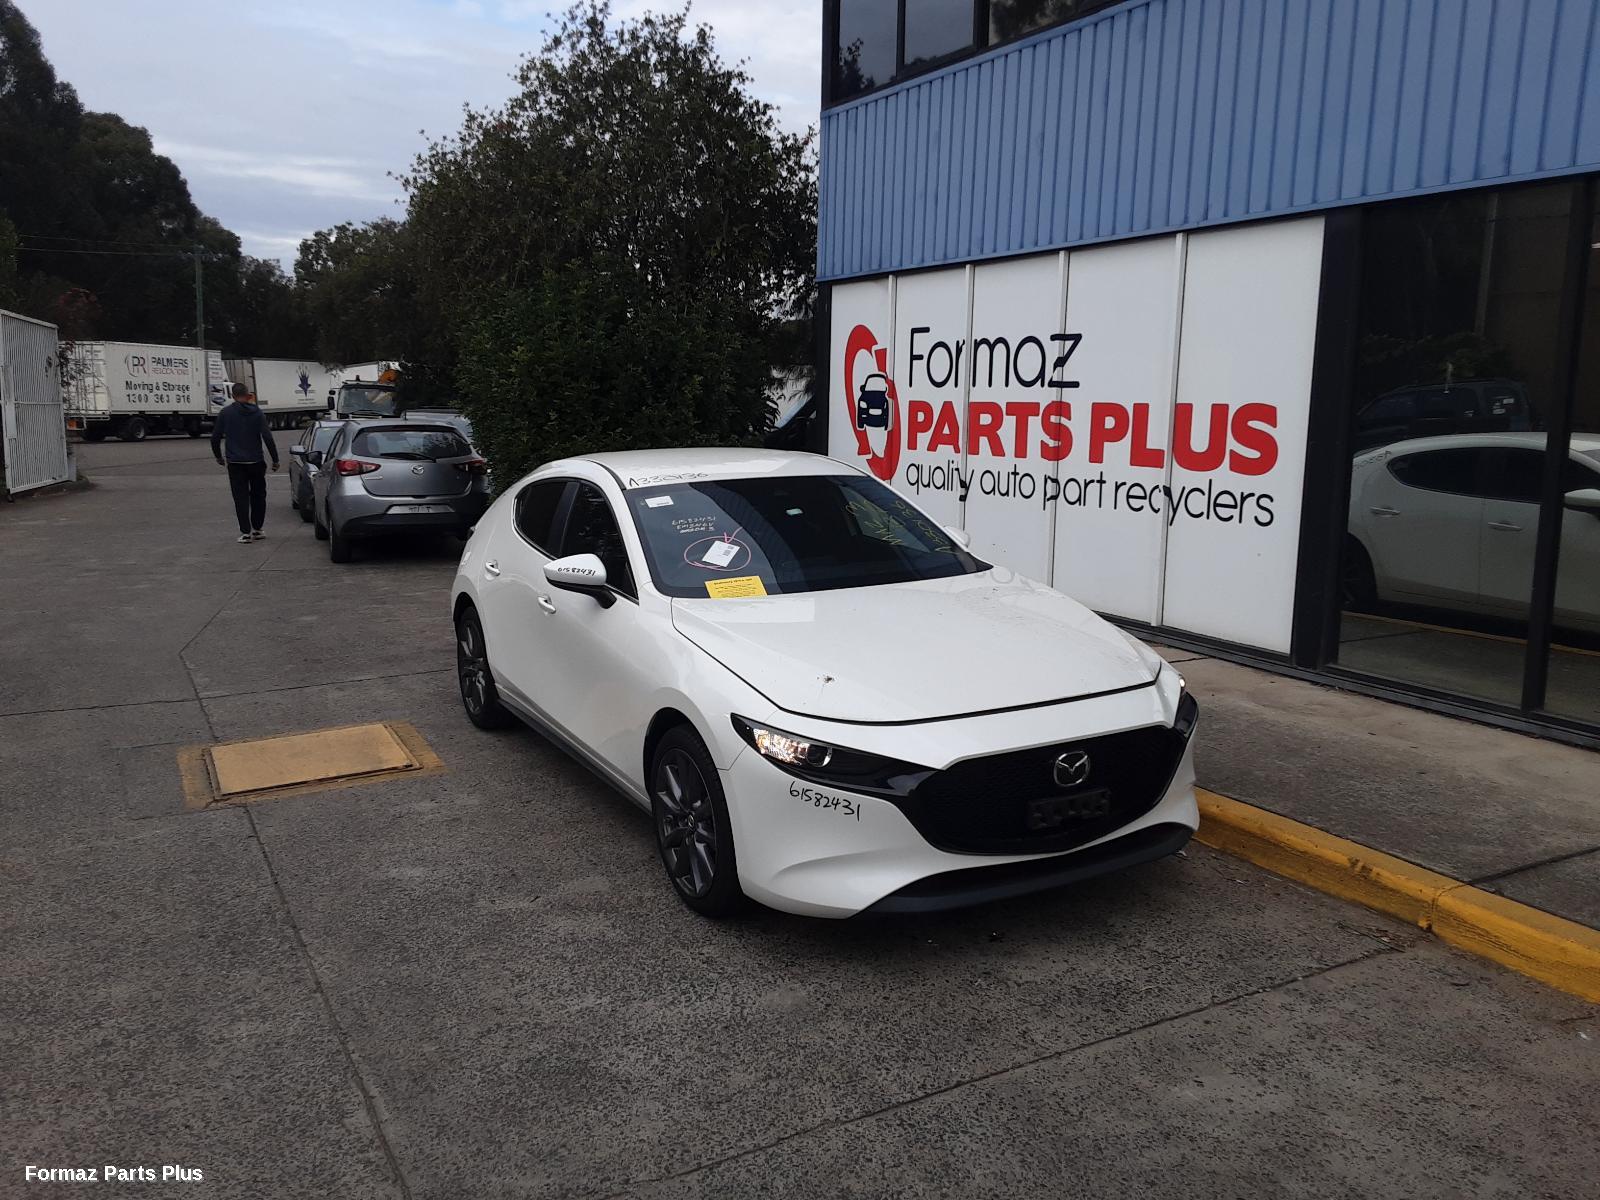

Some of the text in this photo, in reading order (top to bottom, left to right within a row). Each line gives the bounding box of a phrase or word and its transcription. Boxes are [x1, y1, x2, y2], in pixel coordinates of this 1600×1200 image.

[151, 356, 189, 368] PALMERS
[909, 326, 1082, 388] Formaz
[125, 380, 191, 393] Moving & Storage
[126, 393, 149, 403] 1300
[907, 400, 1279, 476] PARTS PLUS
[979, 463, 1036, 500] auto
[1043, 471, 1107, 511] part
[1114, 478, 1274, 527] recyclers
[789, 780, 861, 822] 61582431
